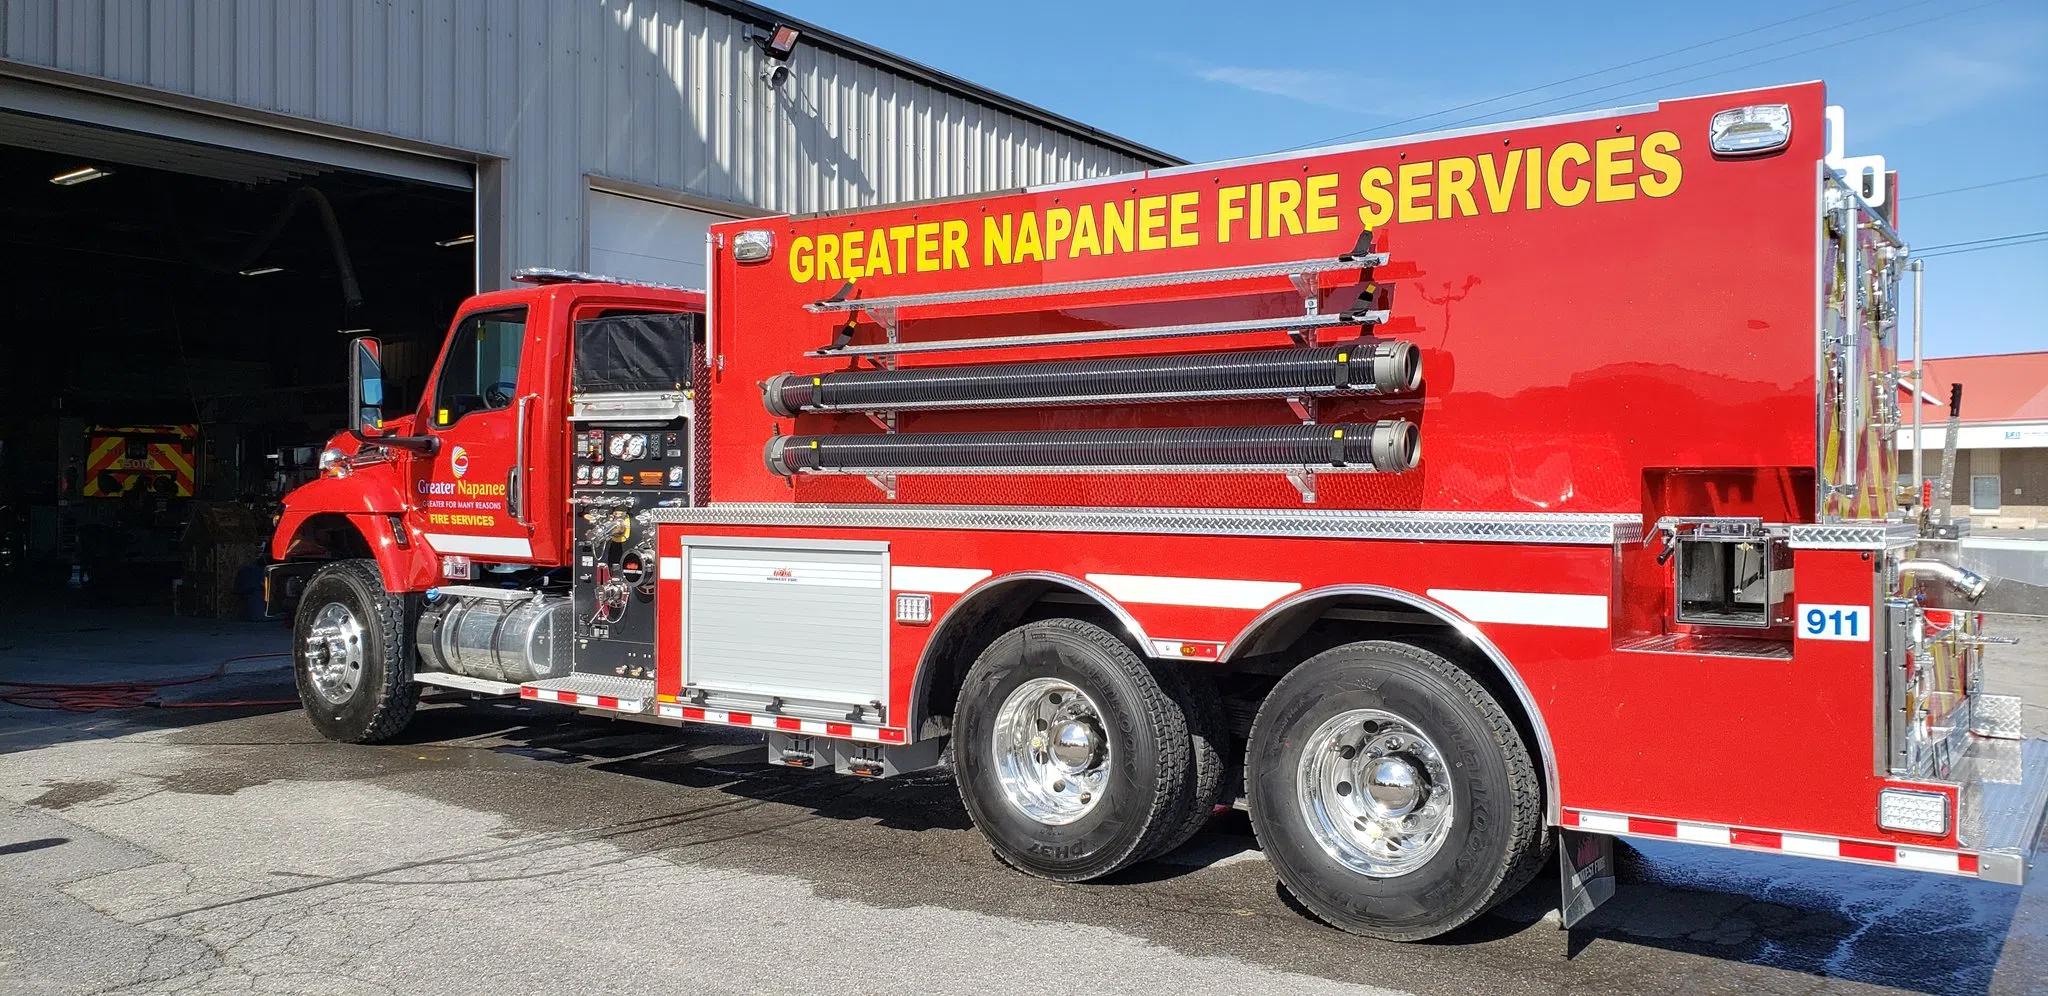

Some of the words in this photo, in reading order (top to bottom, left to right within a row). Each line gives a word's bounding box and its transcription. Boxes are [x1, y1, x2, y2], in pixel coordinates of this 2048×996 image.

[788, 219, 970, 284] GREATER
[983, 190, 1200, 266] NAPANEE
[1217, 172, 1340, 243] FIRE
[1357, 130, 1684, 231] SERVICES
[418, 479, 456, 495] Greater
[457, 480, 505, 499] Napanee
[445, 501, 457, 509] FOR
[457, 501, 474, 509] MANY
[475, 502, 502, 510] REASONS
[429, 514, 449, 524] FIRE
[451, 515, 494, 527] SERVICES
[1807, 608, 1858, 636] 911
